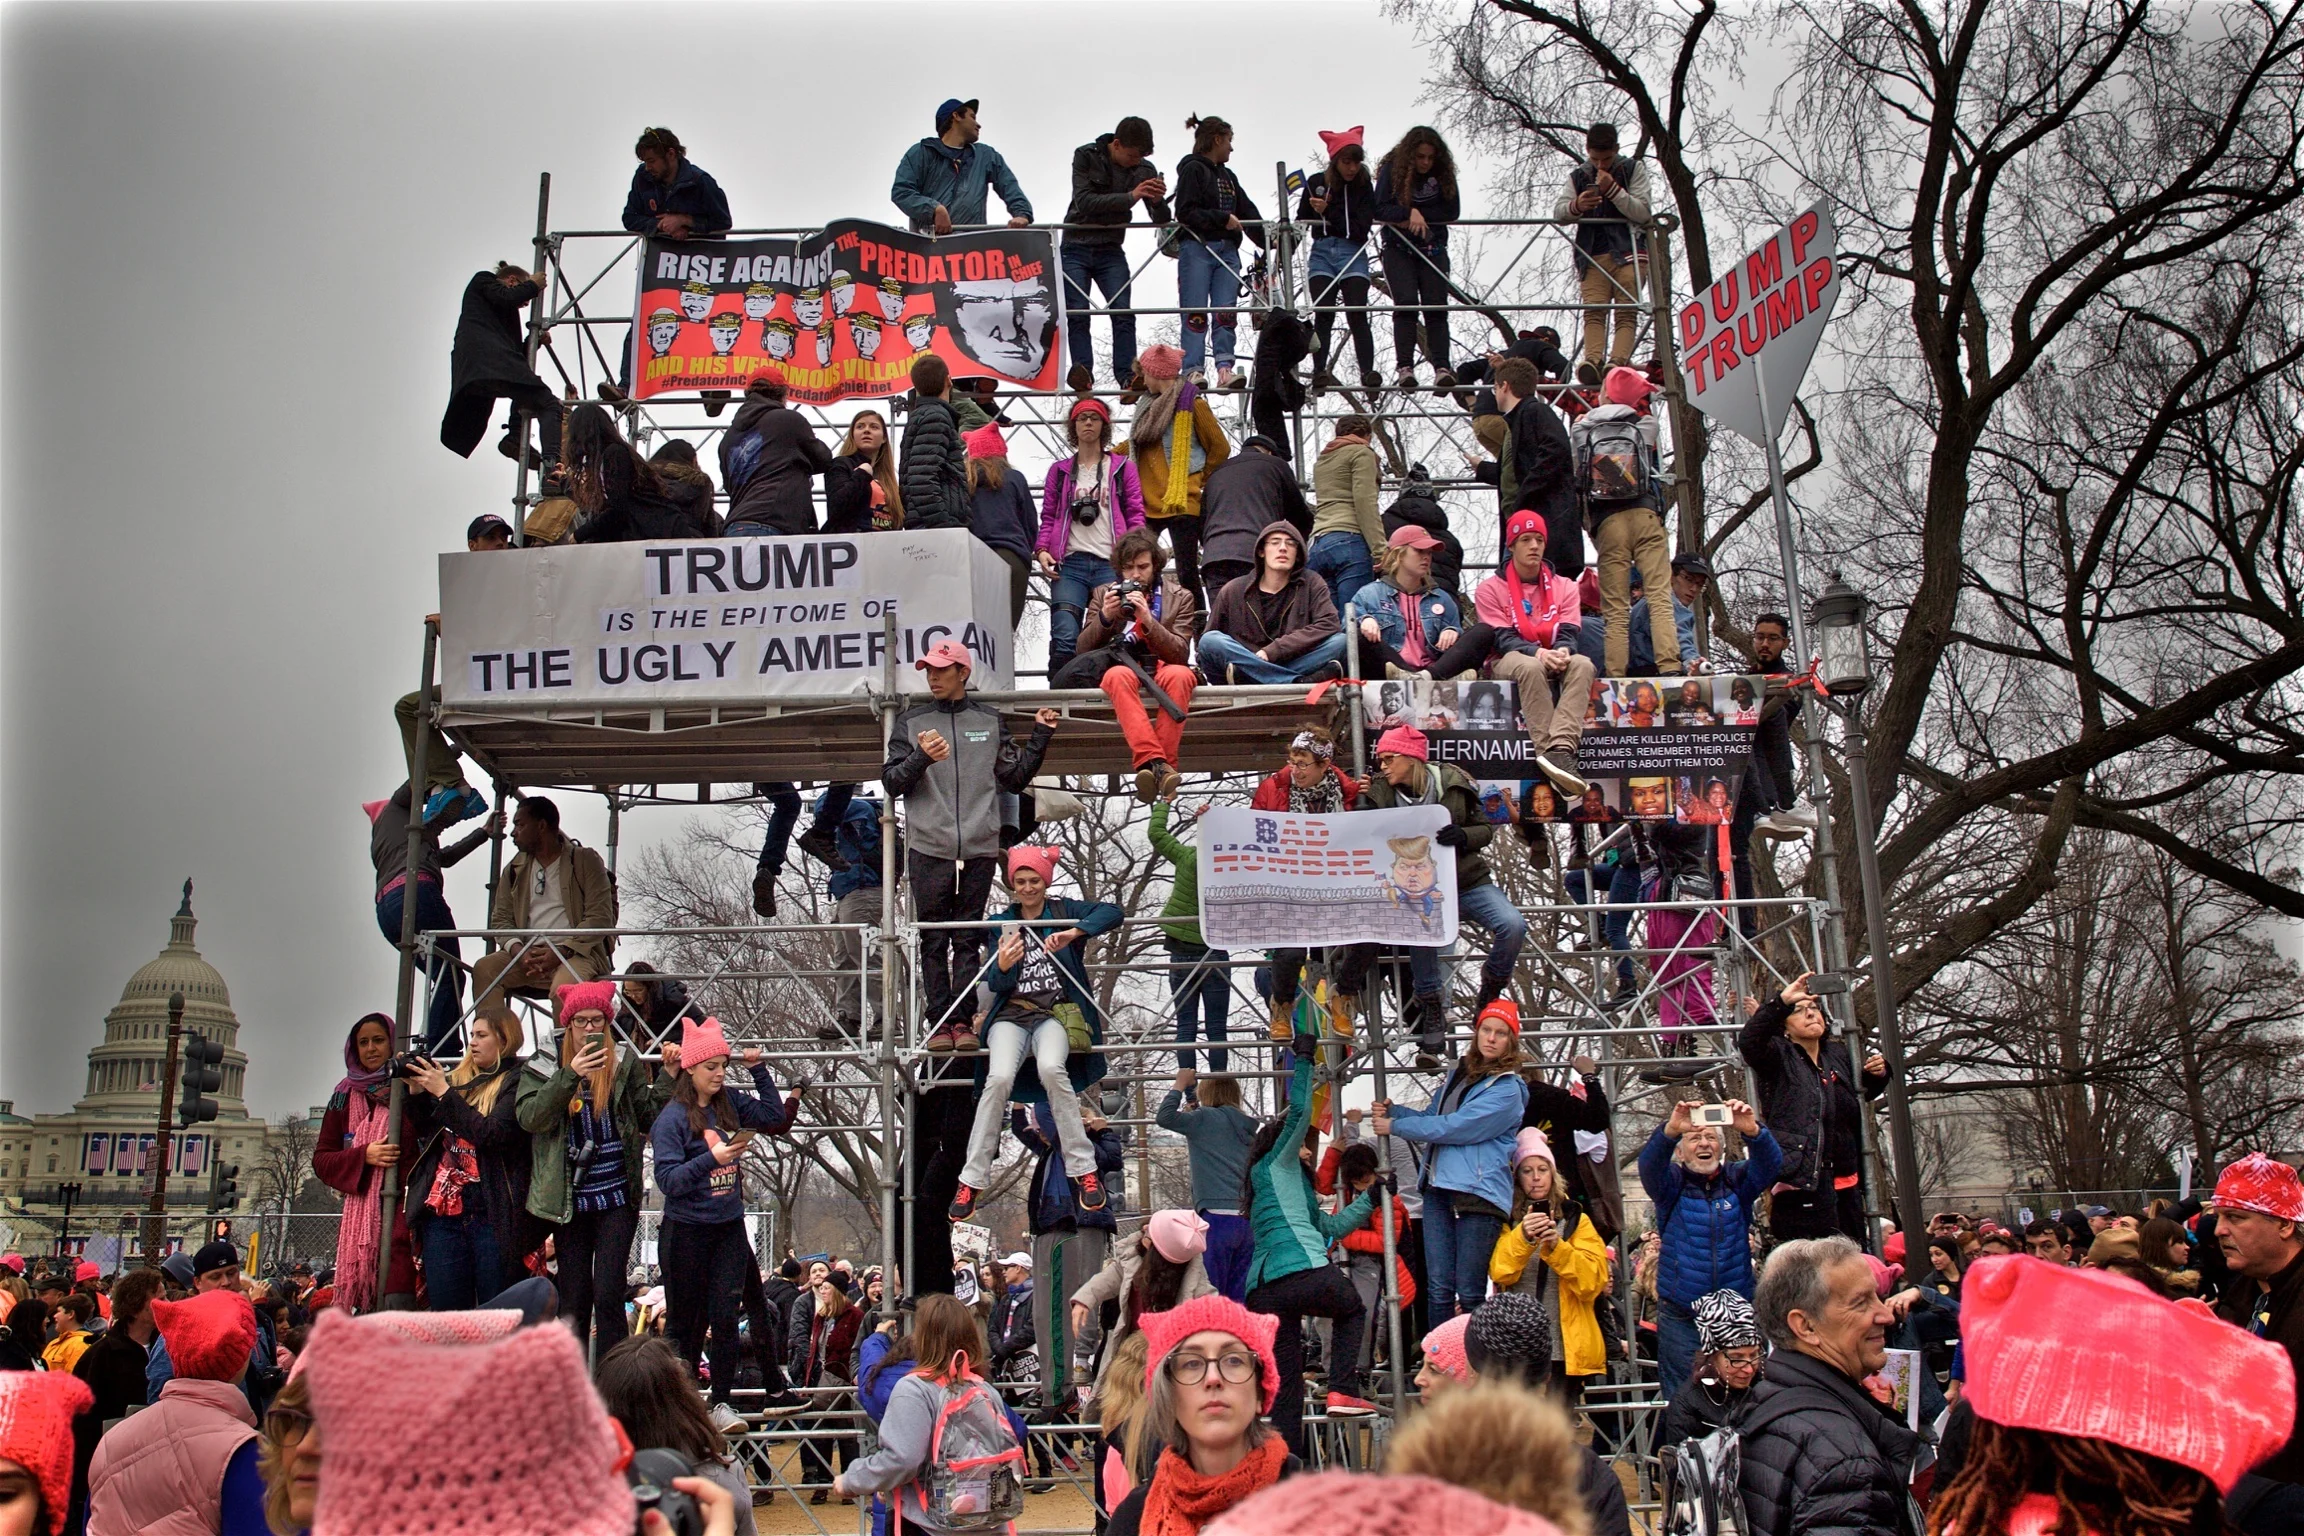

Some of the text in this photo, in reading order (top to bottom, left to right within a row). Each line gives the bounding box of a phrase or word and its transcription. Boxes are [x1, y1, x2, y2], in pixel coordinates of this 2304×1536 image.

[836, 231, 861, 251] THE
[656, 252, 727, 285] RISE
[730, 242, 836, 288] AGAINST
[860, 240, 1006, 284] PREDATOR
[1007, 254, 1023, 268] IN
[1011, 261, 1043, 283] CHIEF
[1679, 210, 1819, 351] DUMP
[1685, 256, 1832, 396] TRUMP
[645, 355, 684, 382] AND
[688, 356, 727, 375] HIS
[843, 349, 934, 382] VILLAIN
[645, 541, 859, 595] TRUMP
[605, 599, 898, 632] IS THE EPITOME OF
[472, 649, 573, 692] THE
[598, 641, 737, 685] UGLY
[1580, 736, 1618, 746] WOMEN
[1619, 735, 1640, 745] ARE
[1641, 734, 1675, 744] KILLED
[1676, 734, 1690, 743] BY
[1691, 733, 1711, 743] THE
[1712, 733, 1746, 742] POLICE
[1598, 748, 1635, 757] NAMES.
[1637, 747, 1692, 756] REMEMBER
[1693, 746, 1723, 755] THEIR
[1577, 757, 1727, 770] OVEMENT IS ABOUT THEM TOO.
[1255, 817, 1330, 847] BAD
[1213, 843, 1376, 876] HOMBRE
